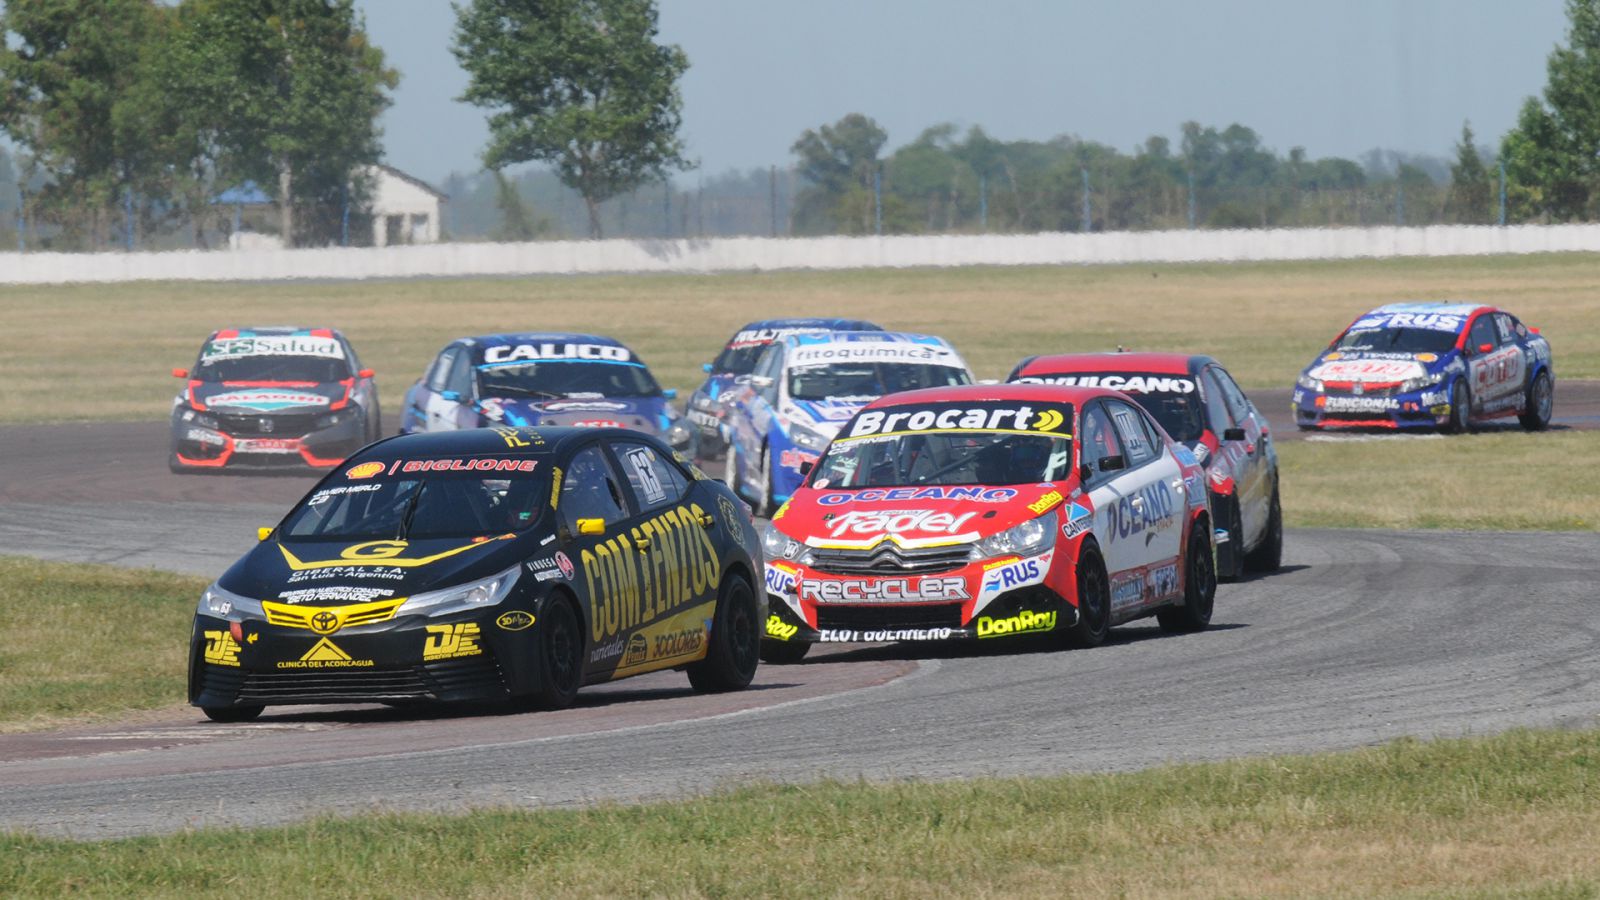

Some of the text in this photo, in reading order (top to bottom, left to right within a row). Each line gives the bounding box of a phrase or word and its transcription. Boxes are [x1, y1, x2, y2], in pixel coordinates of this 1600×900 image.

[1387, 313, 1461, 332] RUS
[257, 340, 335, 354] Salud
[484, 343, 631, 363] CALICO
[850, 406, 1033, 437] Brocart
[403, 459, 538, 473] BIGLIONE
[817, 487, 1018, 506] OCEANO
[1107, 480, 1173, 544] OCEANO
[340, 540, 409, 560] G
[314, 572, 335, 580] Luis
[345, 571, 404, 580] Argentina
[582, 503, 719, 642] COMIENZOS
[766, 568, 794, 595] RUS
[1001, 560, 1039, 588] RUS
[977, 610, 1057, 637] DonRoy
[325, 660, 374, 668] ACONCAGUA
